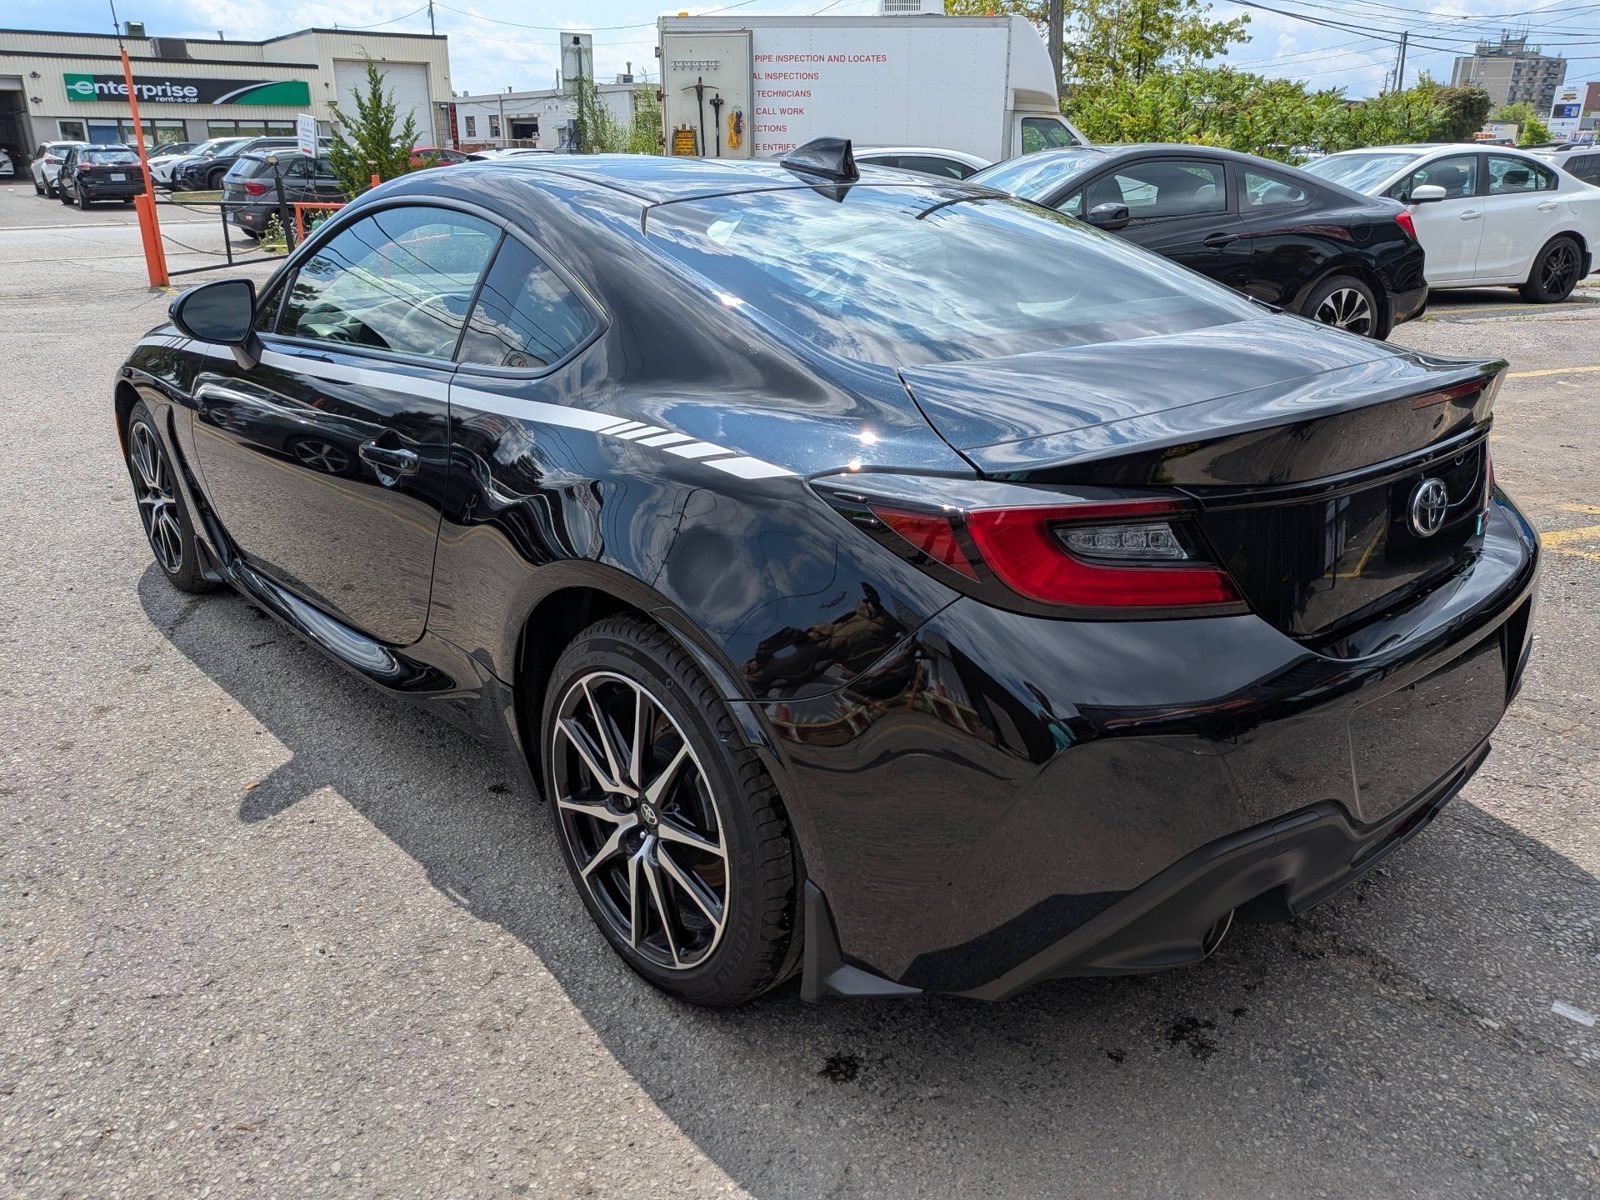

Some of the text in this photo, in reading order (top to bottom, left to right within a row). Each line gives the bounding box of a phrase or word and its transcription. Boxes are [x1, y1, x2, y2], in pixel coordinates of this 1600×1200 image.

[755, 54, 887, 62] PIPE INSPECTION AND LOCATES
[764, 72, 819, 80] INSPECTIONS
[72, 80, 198, 99] enterprise
[757, 90, 812, 98] TECHNICIANS
[756, 107, 805, 115] CALL WORK
